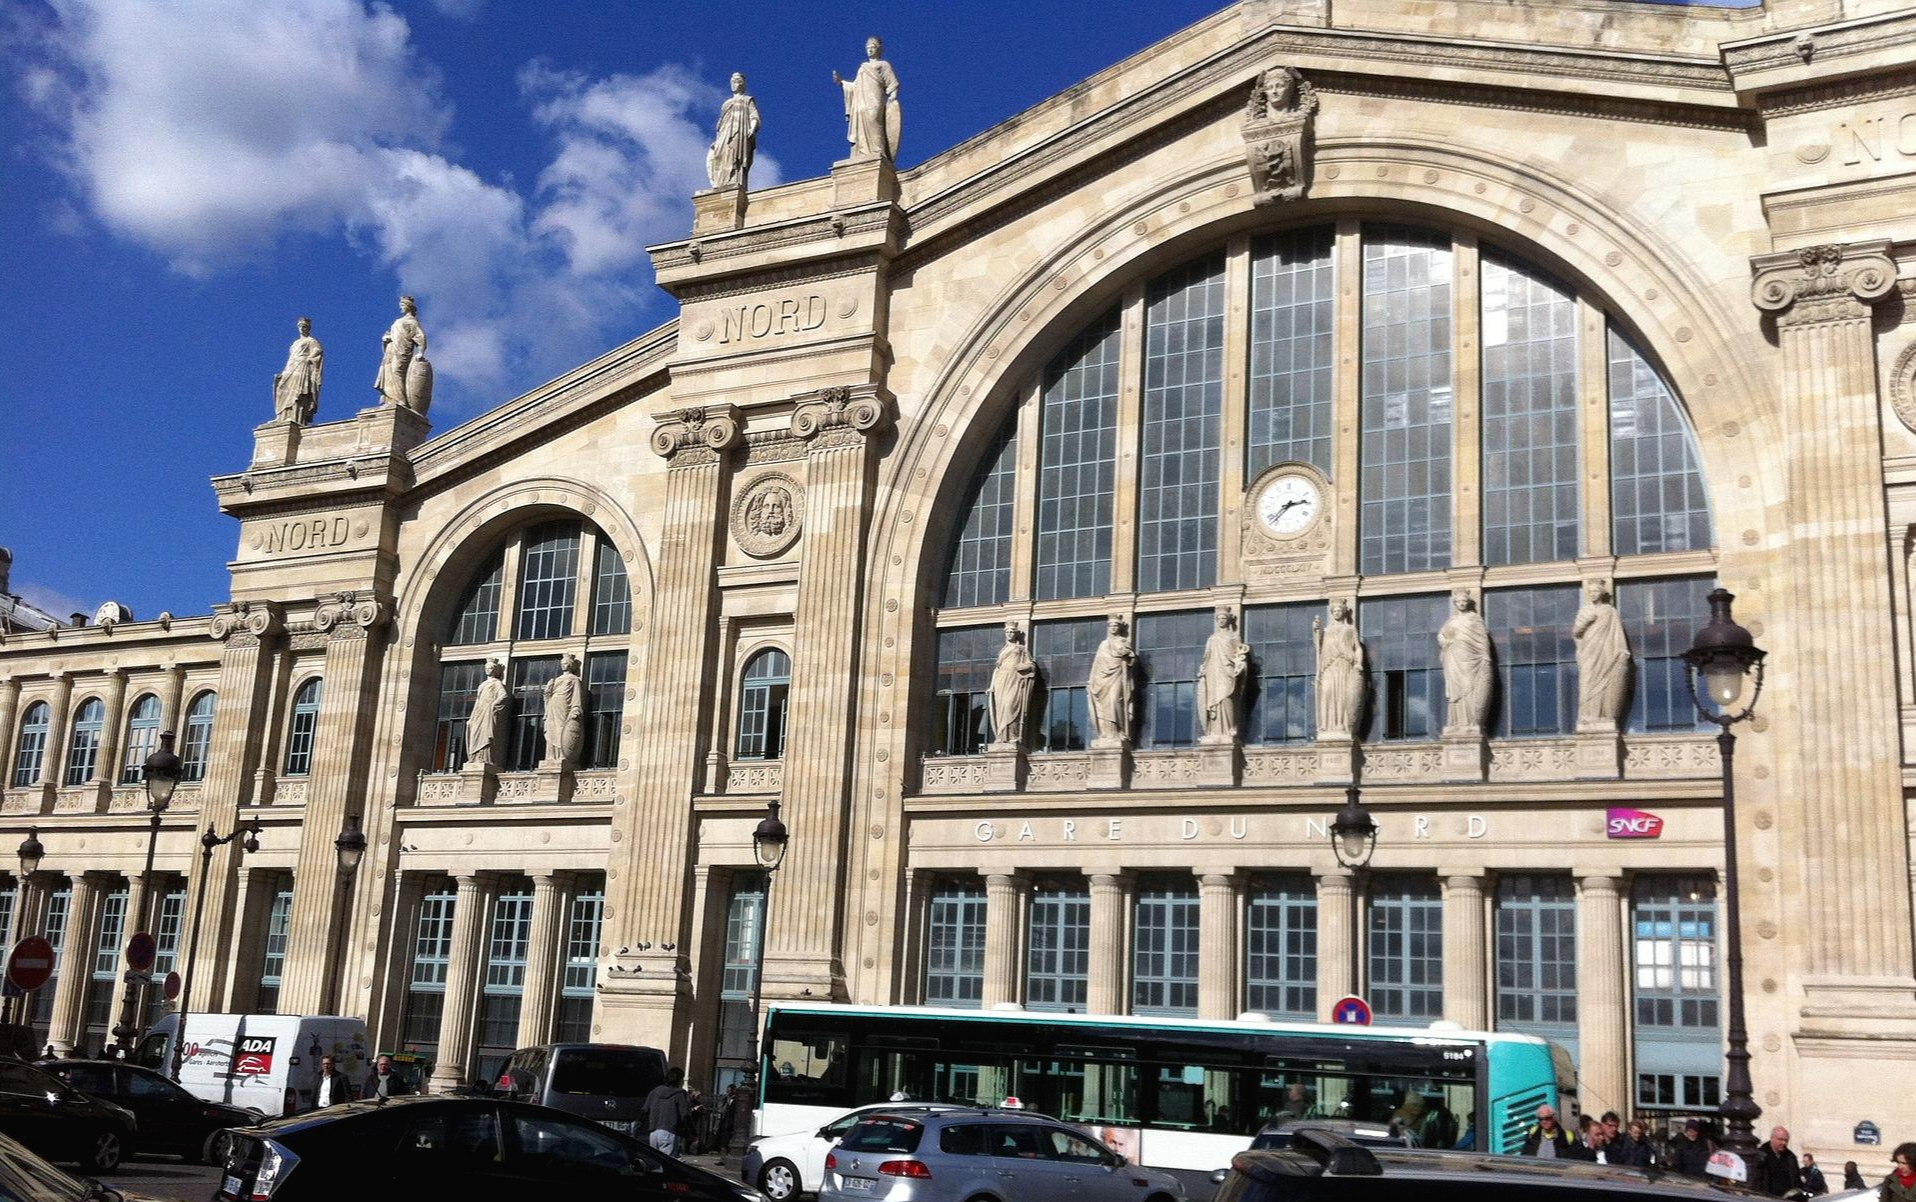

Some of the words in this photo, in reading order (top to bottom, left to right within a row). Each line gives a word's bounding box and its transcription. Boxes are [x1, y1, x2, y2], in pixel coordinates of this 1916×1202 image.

[719, 295, 828, 344] NORD
[265, 517, 350, 554] NORD
[974, 819, 1122, 842] GARE
[1182, 817, 1248, 840] DU
[1609, 818, 1660, 833] SNCF
[240, 1039, 272, 1053] ADA
